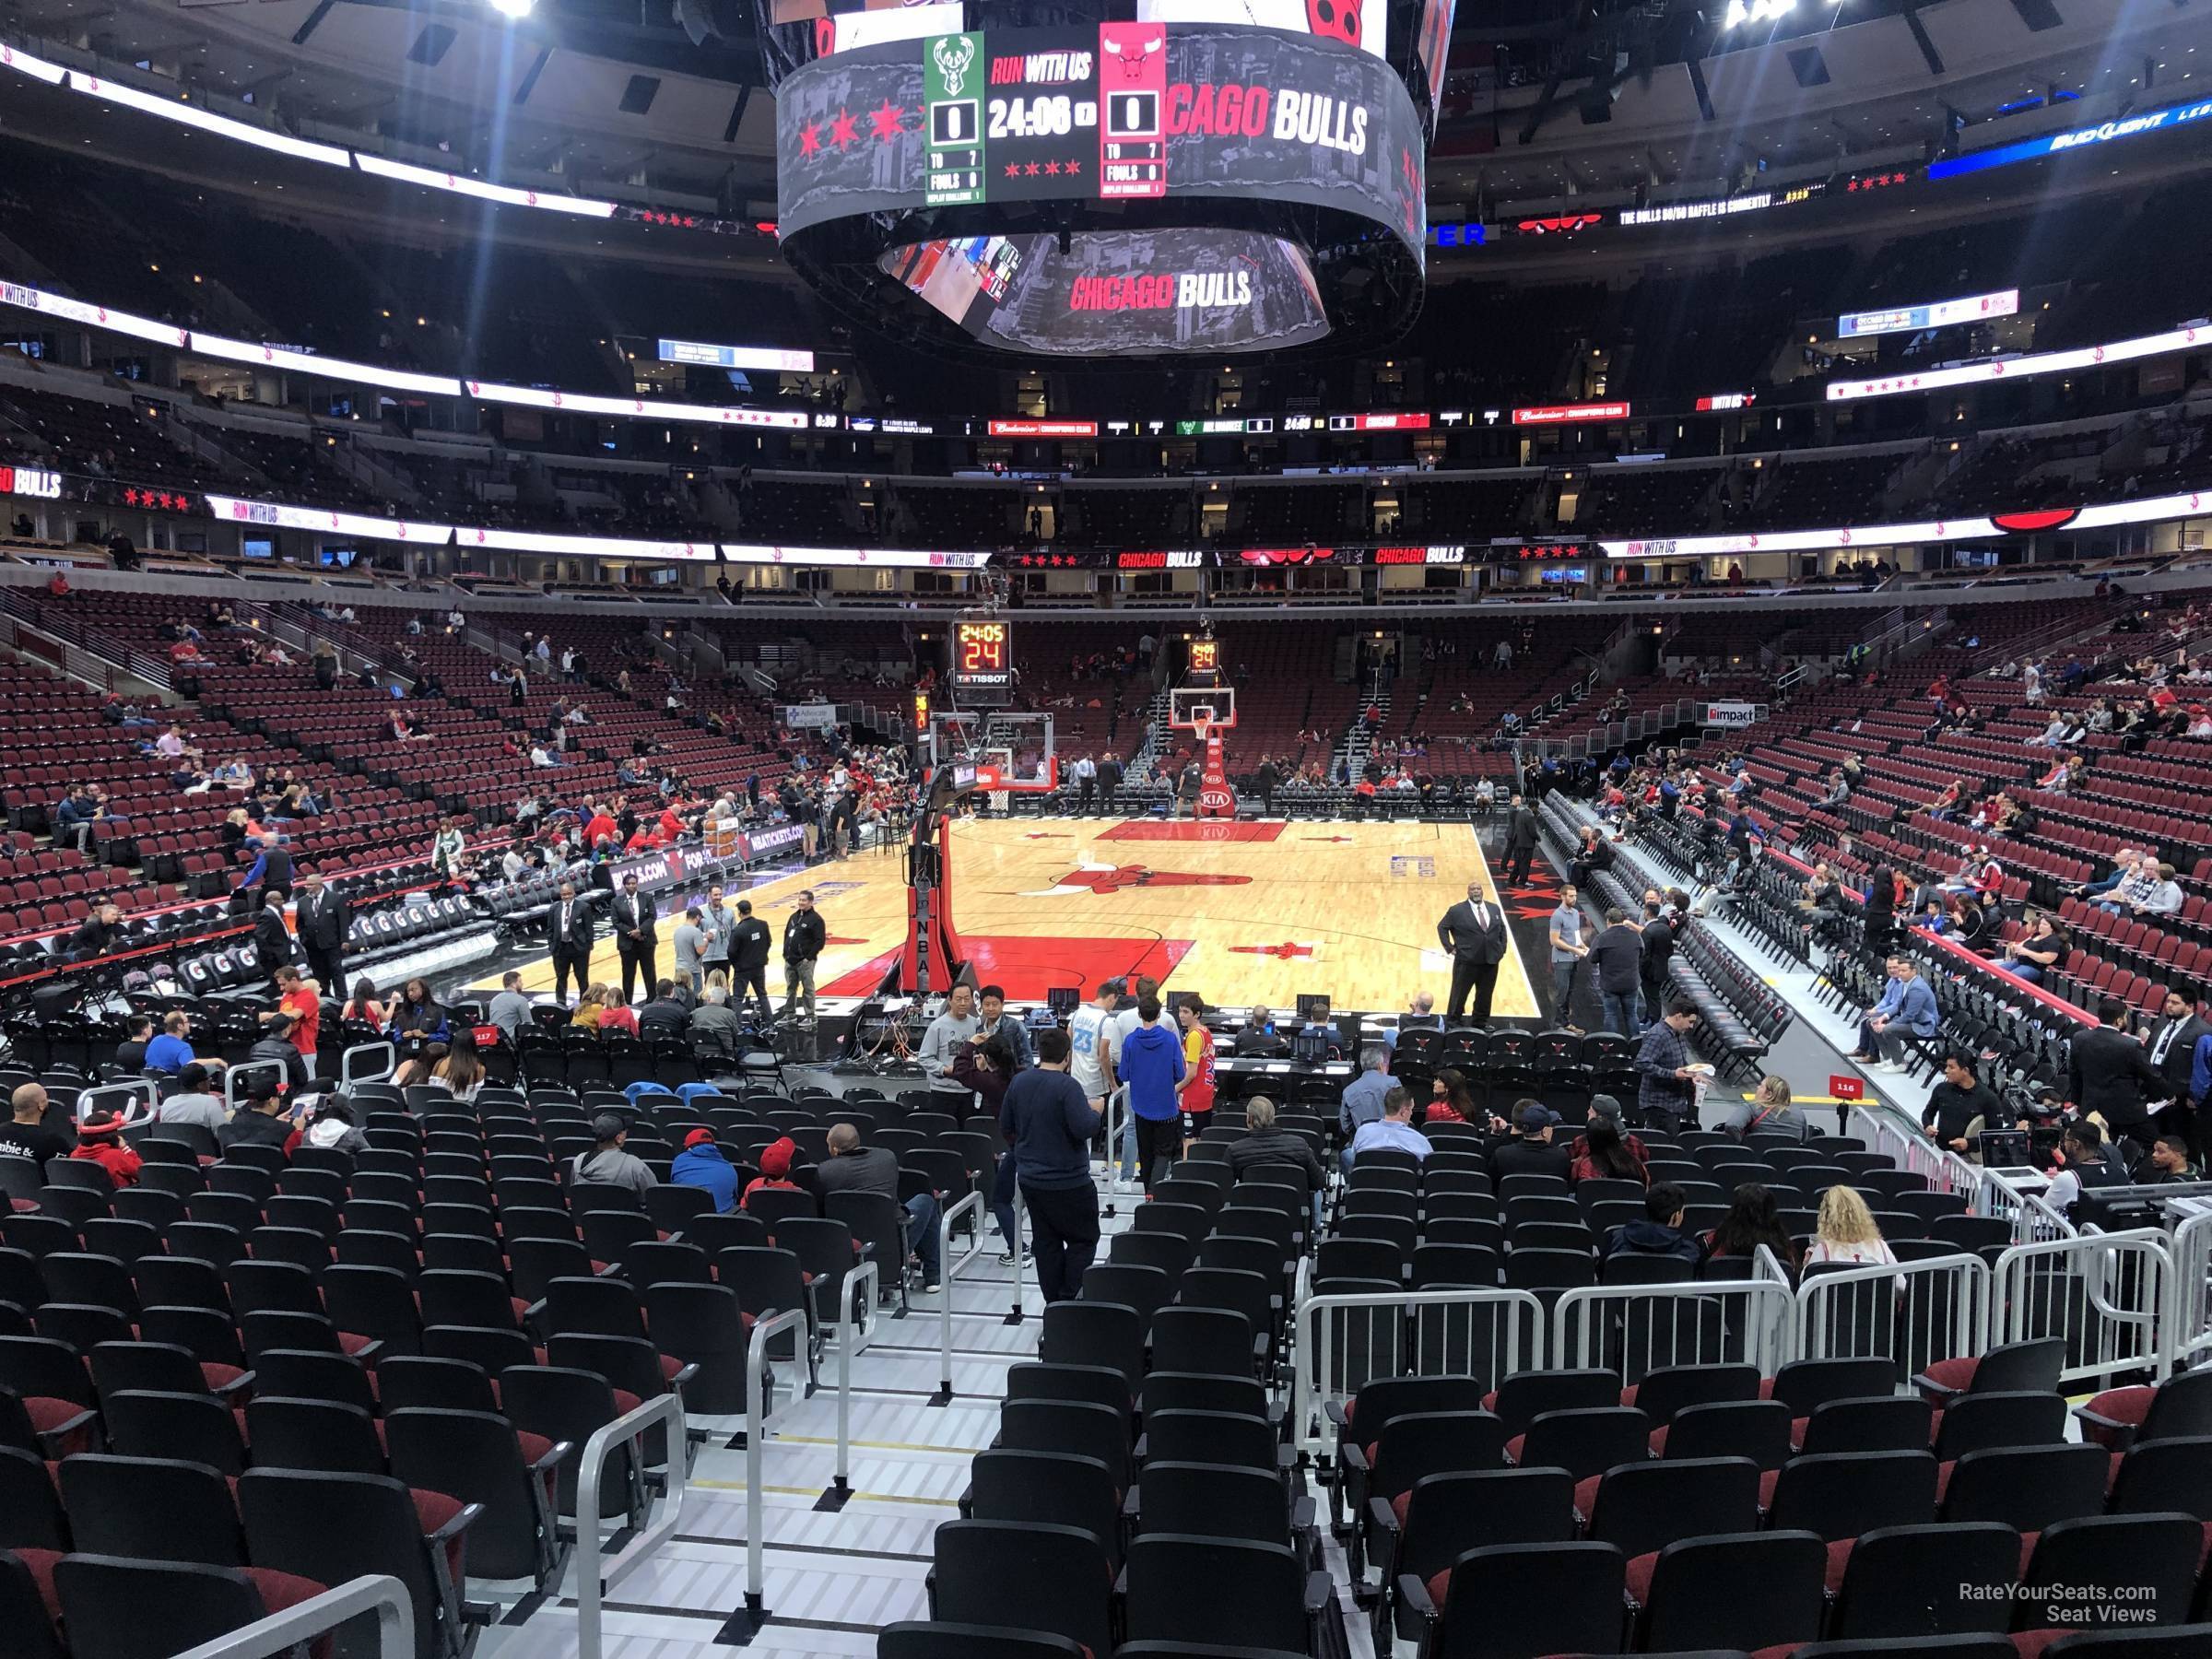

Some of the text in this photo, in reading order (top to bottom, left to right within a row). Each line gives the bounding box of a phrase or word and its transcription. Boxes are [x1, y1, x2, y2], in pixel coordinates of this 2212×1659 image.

[991, 52, 1092, 85] RUN WITH US
[947, 106, 961, 139] 0
[1125, 97, 1140, 130] 0
[1165, 83, 1368, 156] CAGO BULLS
[2049, 130, 2098, 151] BUD
[931, 150, 976, 169] TO 7
[1106, 143, 1156, 159] TO 7
[930, 171, 977, 190] FOULS 0
[1106, 164, 1157, 182] FOULS 0
[1620, 211, 1635, 225] THE
[1636, 208, 1661, 223] BULLS
[1688, 202, 1717, 218] RAFFLE
[1718, 201, 1726, 215] IS
[1426, 223, 1487, 247] ER
[5, 283, 26, 305] WITH
[27, 288, 38, 308] US
[1070, 270, 1252, 312] CHICAGO BULLS
[1695, 397, 1712, 411] RUN
[1519, 409, 1565, 421] Budweiser
[994, 423, 1038, 433] Budweiser
[14, 468, 62, 499] BULLS
[232, 501, 278, 524] RUN WITH US
[1374, 546, 1465, 564] CHICAGO BULLS
[1627, 540, 1677, 556] RUN WITH US
[929, 553, 975, 567] RUN WITH US
[1118, 551, 1202, 568] CHICAGO BULLS
[960, 624, 1003, 642] 24:05
[966, 642, 999, 669] 24
[1194, 653, 1213, 667] 24
[971, 675, 1008, 683] TISSOT
[1717, 706, 1753, 723] impact
[1203, 794, 1225, 805] KIA
[750, 825, 806, 852] NBATICKETS.CO
[611, 860, 667, 891] BS.COM
[684, 851, 703, 870] FOR
[427, 903, 440, 918] G
[443, 899, 455, 913] G
[459, 895, 471, 910] G
[378, 915, 391, 932] G
[394, 912, 407, 927] G
[409, 908, 422, 923] G
[360, 919, 374, 935] G
[918, 921, 929, 973] NBA
[214, 954, 232, 972] G
[239, 948, 256, 967] G
[188, 961, 206, 980] G
[476, 1032, 491, 1041] 117
[1073, 1028, 1093, 1053] 23
[1837, 1083, 1854, 1092] 116
[23, 1147, 34, 1158] &
